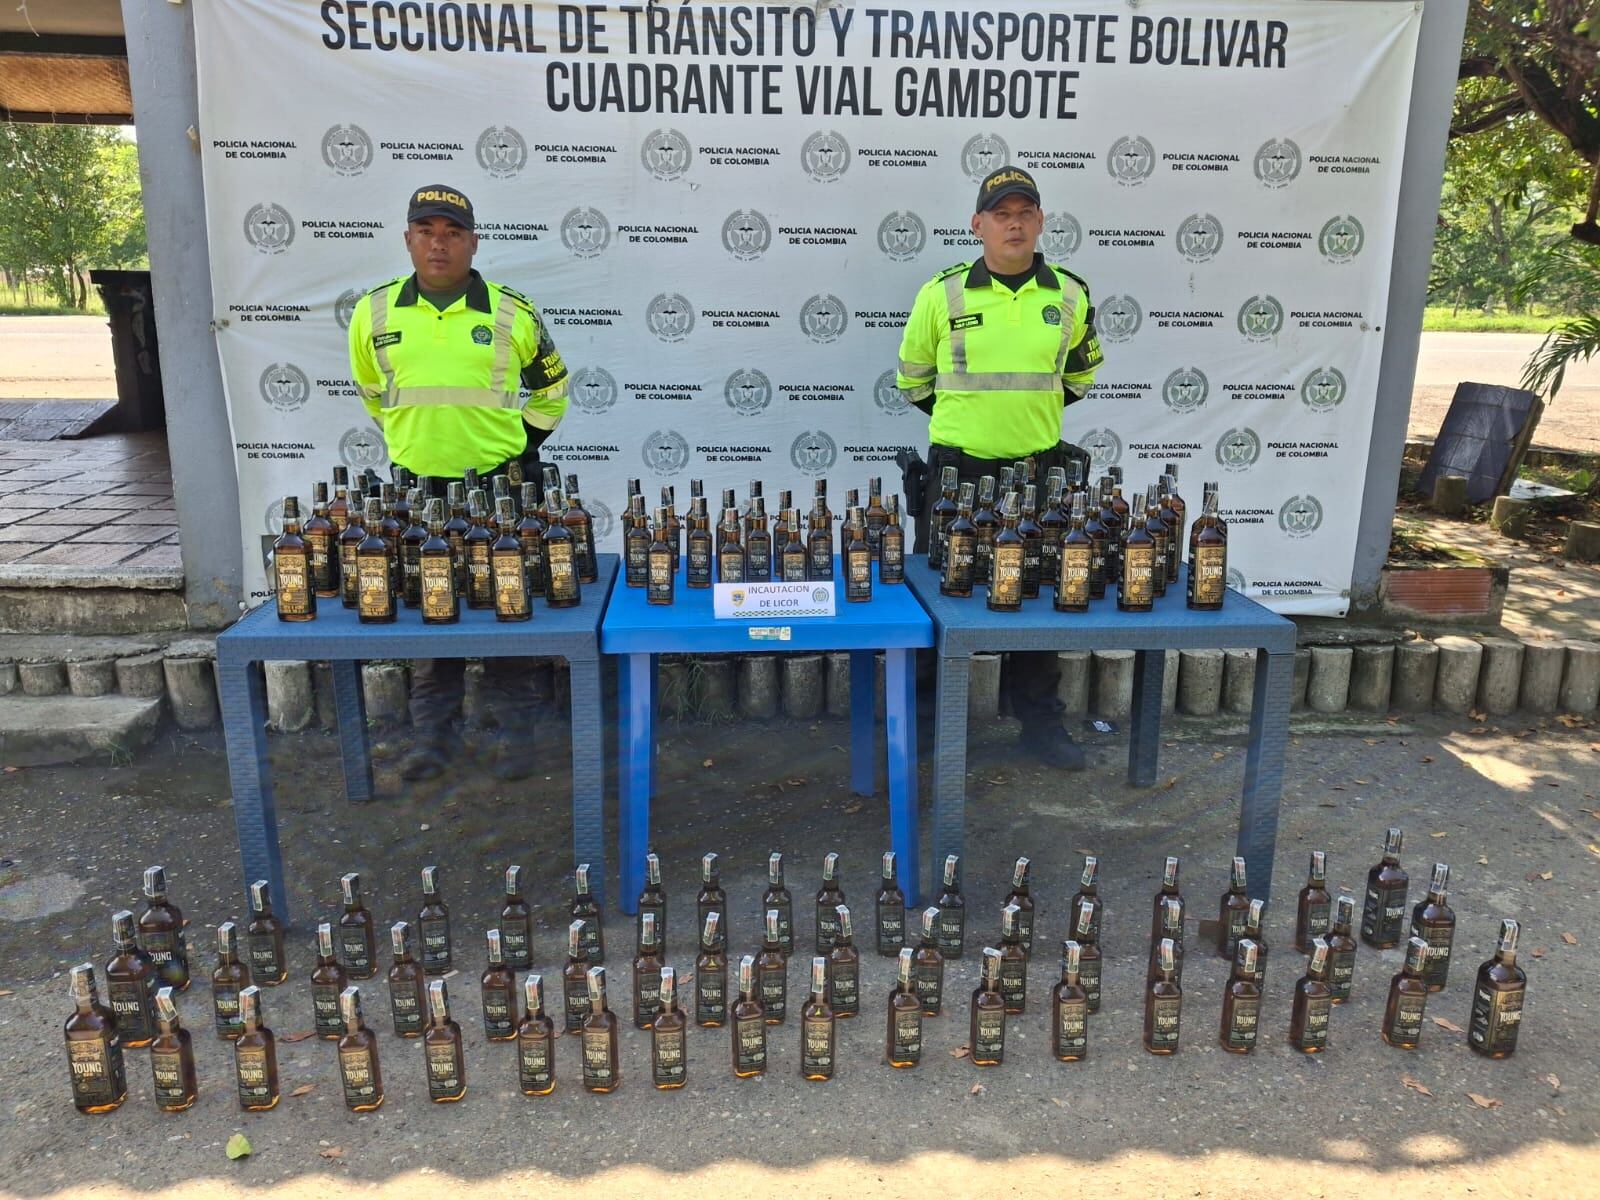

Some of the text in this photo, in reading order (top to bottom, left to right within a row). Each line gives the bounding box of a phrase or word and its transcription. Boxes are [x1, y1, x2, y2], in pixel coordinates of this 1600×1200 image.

[321, 0, 1289, 68] SECCIONAL DE TRÁNSITO Y TRANSPORTE BOLIVAR
[545, 61, 1080, 119] CUADRANTE VIAL GAMBOTE
[212, 140, 296, 149] POLICIA NACIONAL
[380, 142, 464, 151] POLICIA NACIONAL
[534, 144, 618, 153] POLICIA NACIONAL
[224, 150, 286, 159] DE COLOMBIA
[698, 146, 780, 156] POLICIA NACIONAL
[858, 148, 938, 158] POLICIA NACIONAL
[1018, 150, 1096, 160] POLICIA NACIONAL
[392, 152, 454, 161] DE COLOMBIA
[546, 154, 606, 164] DE COLOMBIA
[1162, 153, 1240, 162] POLICIA NACIONAL
[1308, 155, 1380, 165] POLICIA NACIONAL
[710, 157, 770, 166] DE COLOMBIA
[868, 159, 928, 168] DE COLOMBIA
[1028, 161, 1086, 170] DE COLOMBIA
[1172, 163, 1228, 172] DE COLOMBIA
[1318, 165, 1370, 174] DE COLOMBIA
[417, 190, 468, 209] POLICIA
[302, 220, 384, 229] POLICIA NACIONAL
[314, 230, 374, 239] DE COLOMBIA
[778, 226, 858, 236] POLICIA NACIONAL
[1088, 229, 1166, 237] POLICIA NACIONAL
[1238, 231, 1312, 240] POLICIA NACIONAL
[788, 236, 848, 246] DE COLOMBIA
[1098, 239, 1154, 247] DE COLOMBIA
[1246, 241, 1302, 249] DE COLOMBIA
[230, 304, 312, 314] POLICIA NACIONAL
[542, 307, 624, 317] POLICIA NACIONAL
[240, 313, 302, 322] DE COLOMBIA
[702, 310, 780, 319] POLICIA NACIONAL
[1290, 311, 1364, 319] POLICIA NACIONAL
[554, 317, 612, 327] DE COLOMBIA
[712, 320, 770, 328] DE COLOMBIA
[1298, 320, 1352, 328] DE COLOMBIA
[624, 383, 702, 392] POLICIA NACIONAL
[1222, 383, 1296, 392] POLICIA NACIONAL
[648, 392, 692, 401] COLOMBIA
[1232, 392, 1286, 401] DE COLOMBIA
[236, 442, 316, 451] POLICIA NACIONAL
[542, 444, 620, 453] POLICIA NACIONAL
[696, 445, 772, 454] POLICIA NACIONAL
[1128, 442, 1202, 451] POLICIA NACIONAL
[1266, 441, 1338, 449] POLICIA NACIONAL
[248, 451, 306, 460] DE COLOMBIA
[566, 454, 610, 462] COLOMBIA
[1138, 451, 1192, 459] DE COLOMBIA
[1276, 450, 1328, 458] DE COLOMBIA
[468, 564, 490, 574] YOUNG
[279, 574, 302, 585] YOUNG
[361, 576, 384, 587] YOUNG
[425, 577, 448, 587] YOUNG
[496, 575, 518, 586] YOUNG
[748, 585, 810, 594] INCAUTACION
[760, 599, 799, 607] DE LICOR
[1427, 947, 1448, 956] YOUNG
[112, 1001, 139, 1012] YOUNG
[216, 1000, 238, 1009] YOUNG
[1500, 1011, 1521, 1022] YOUNG
[658, 1050, 680, 1059] YOUNG
[524, 1057, 546, 1066] YOUNG
[72, 1062, 102, 1073] YOUNG
[431, 1063, 453, 1072] YOUNG
[155, 1071, 178, 1081] YOUNG
[240, 1070, 263, 1079] YOUNG
[345, 1070, 368, 1080] YOUNG
